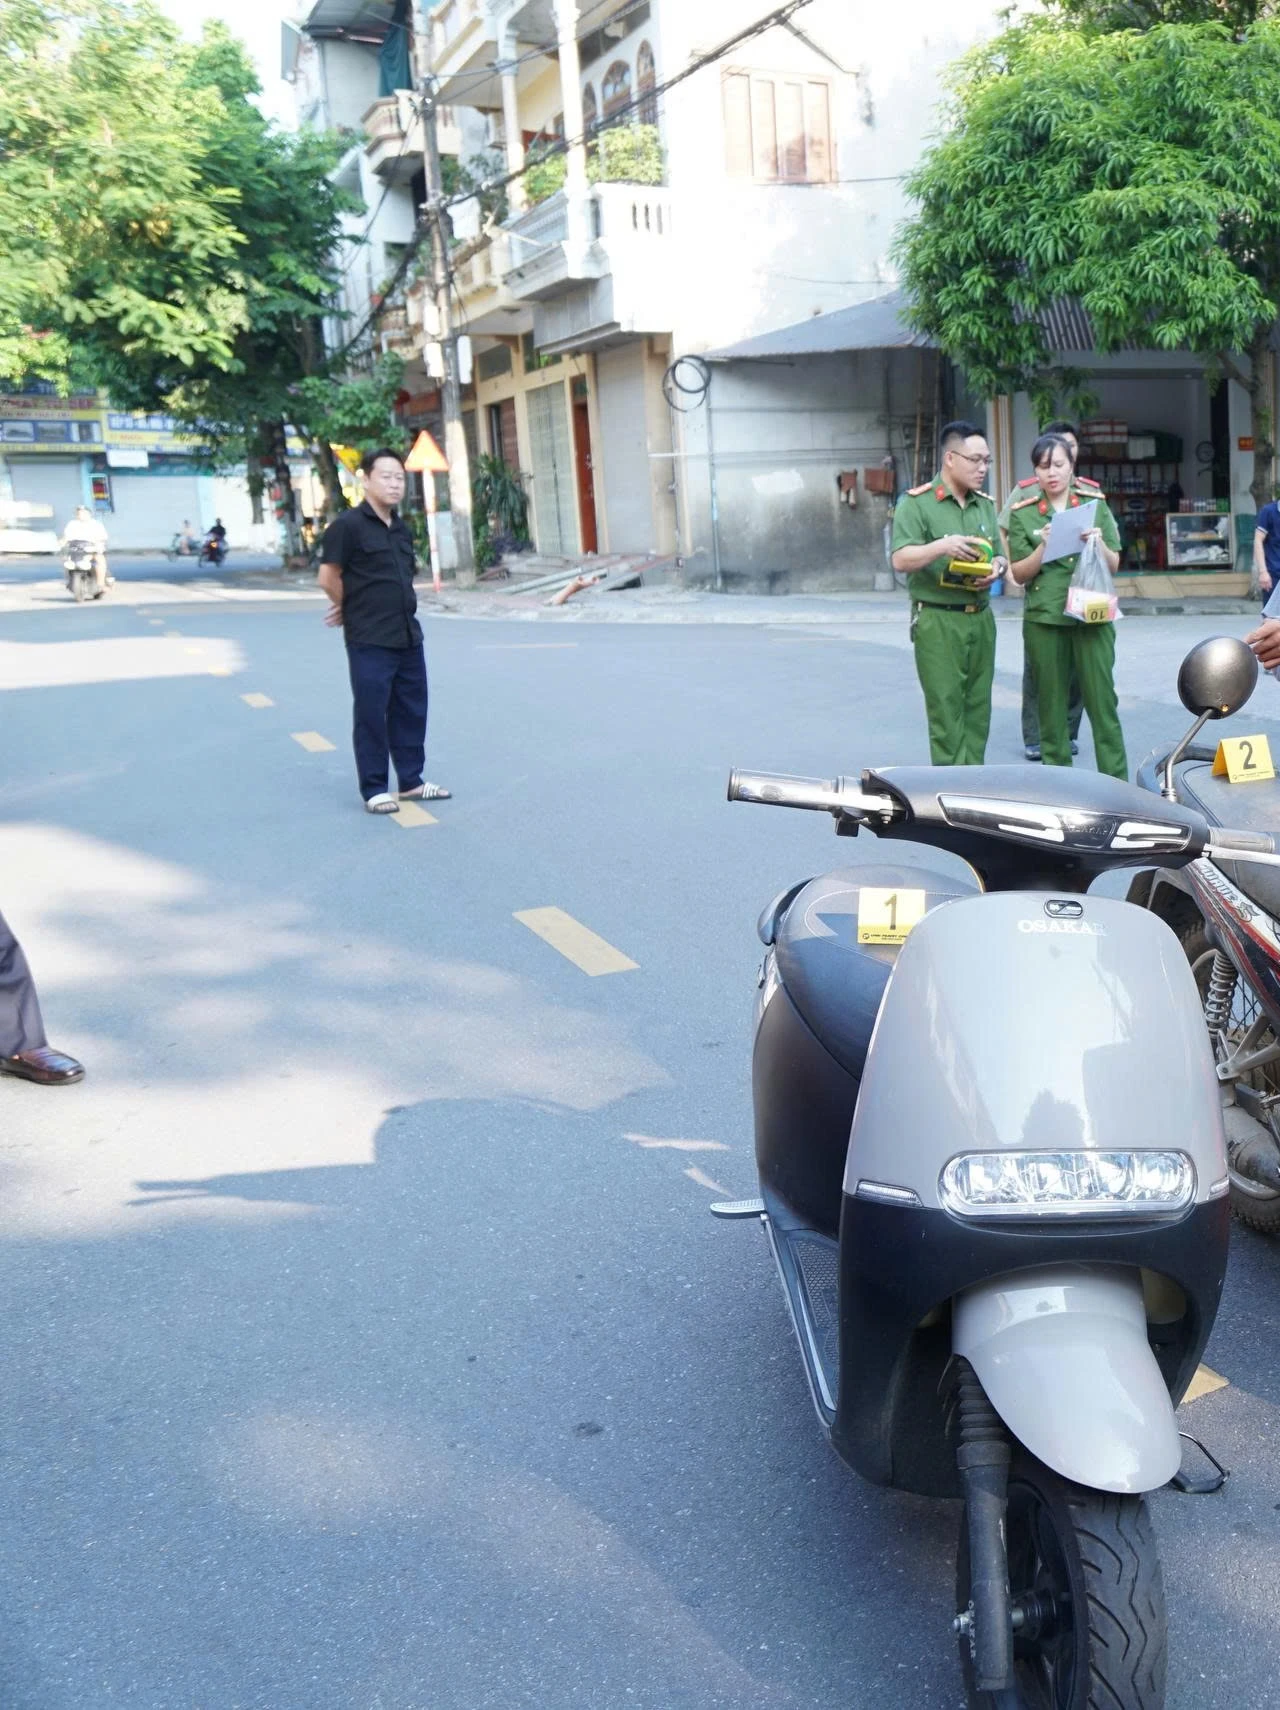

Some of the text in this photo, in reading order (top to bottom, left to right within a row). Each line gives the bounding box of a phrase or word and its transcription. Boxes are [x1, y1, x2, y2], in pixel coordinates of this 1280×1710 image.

[1090, 610, 1105, 620] 10
[1239, 740, 1256, 769] 2
[884, 893, 897, 930] 1
